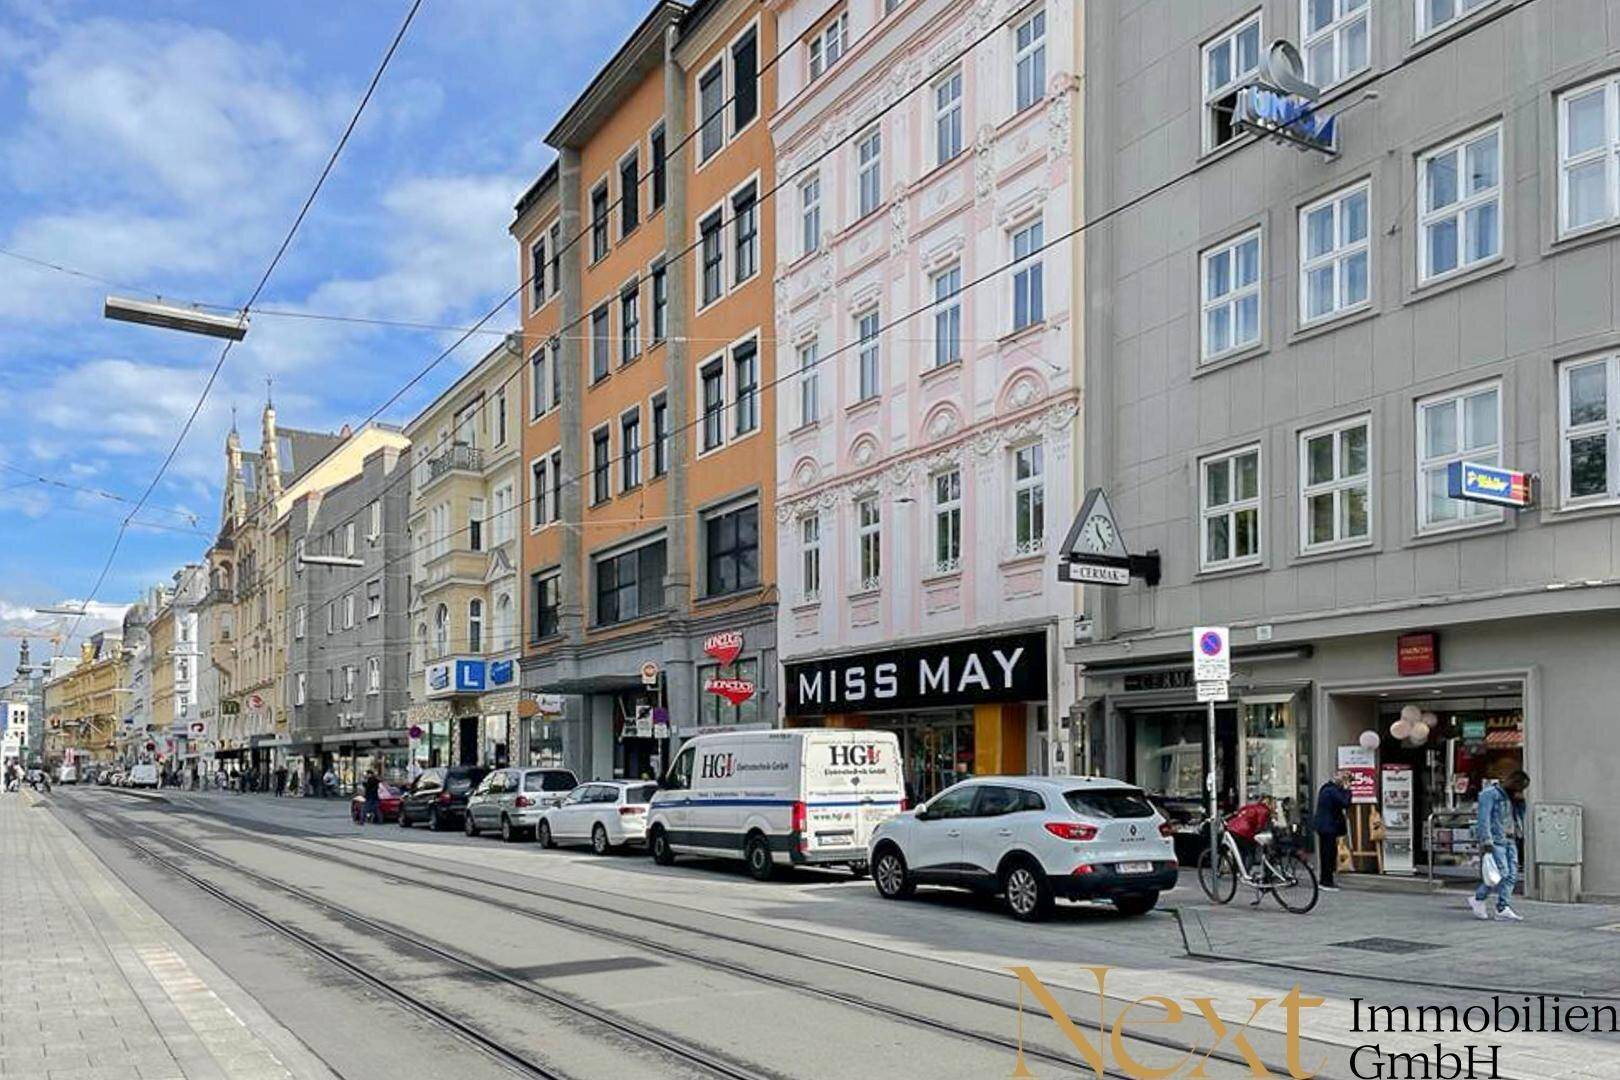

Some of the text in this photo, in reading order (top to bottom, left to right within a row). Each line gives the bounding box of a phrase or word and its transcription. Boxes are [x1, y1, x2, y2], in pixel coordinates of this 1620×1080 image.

[463, 664, 479, 687] L
[800, 647, 1024, 704] MISS MAY
